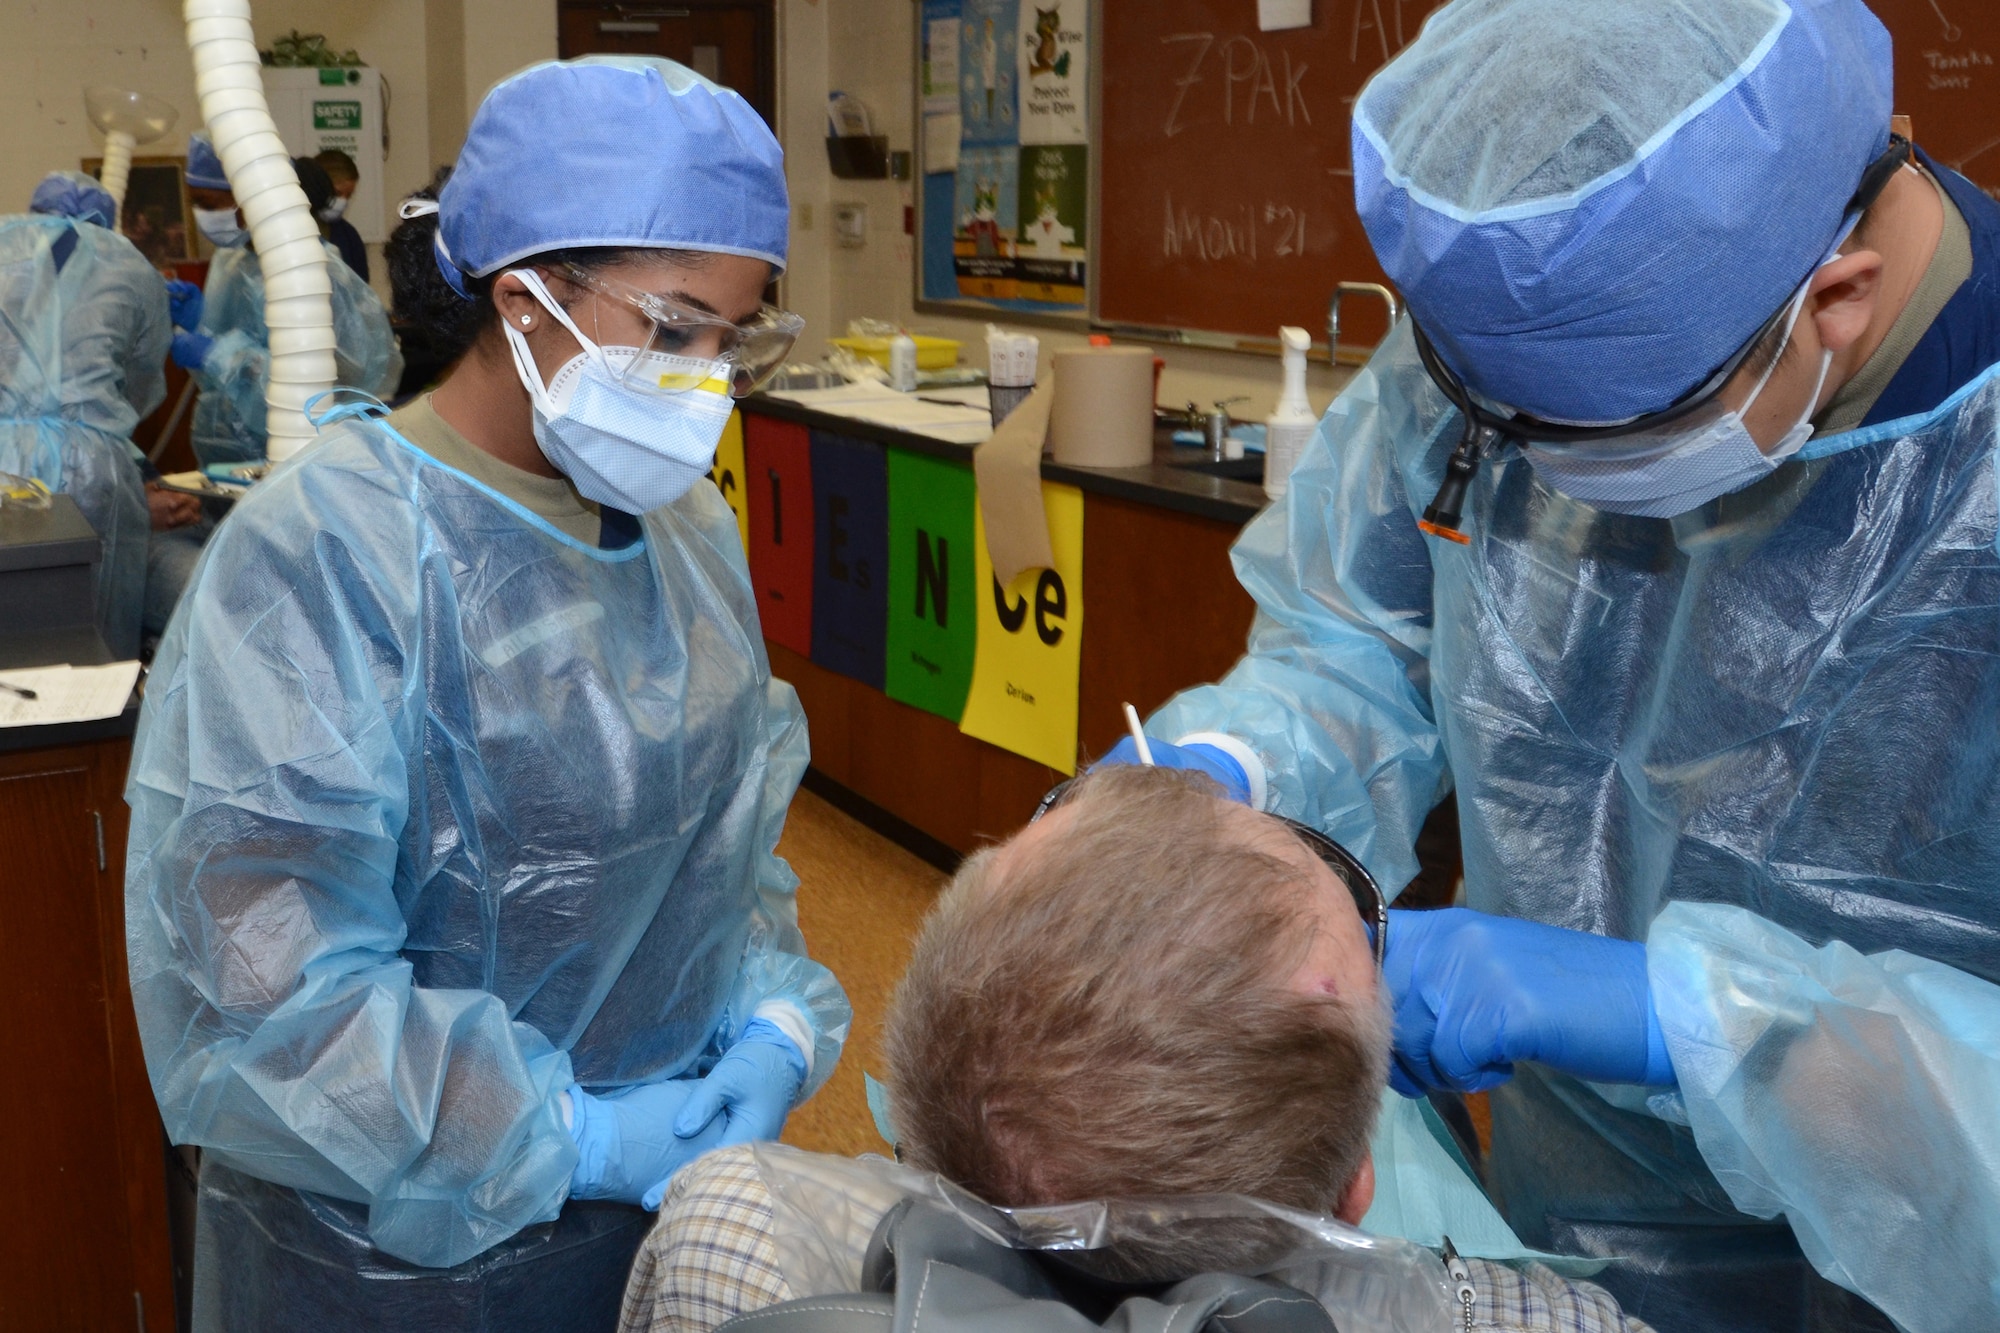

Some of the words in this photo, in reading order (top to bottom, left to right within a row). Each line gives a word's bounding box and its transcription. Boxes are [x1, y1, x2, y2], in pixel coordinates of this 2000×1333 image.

[316, 105, 359, 117] SAFETY
[1028, 102, 1051, 115] Your
[915, 525, 949, 629] N
